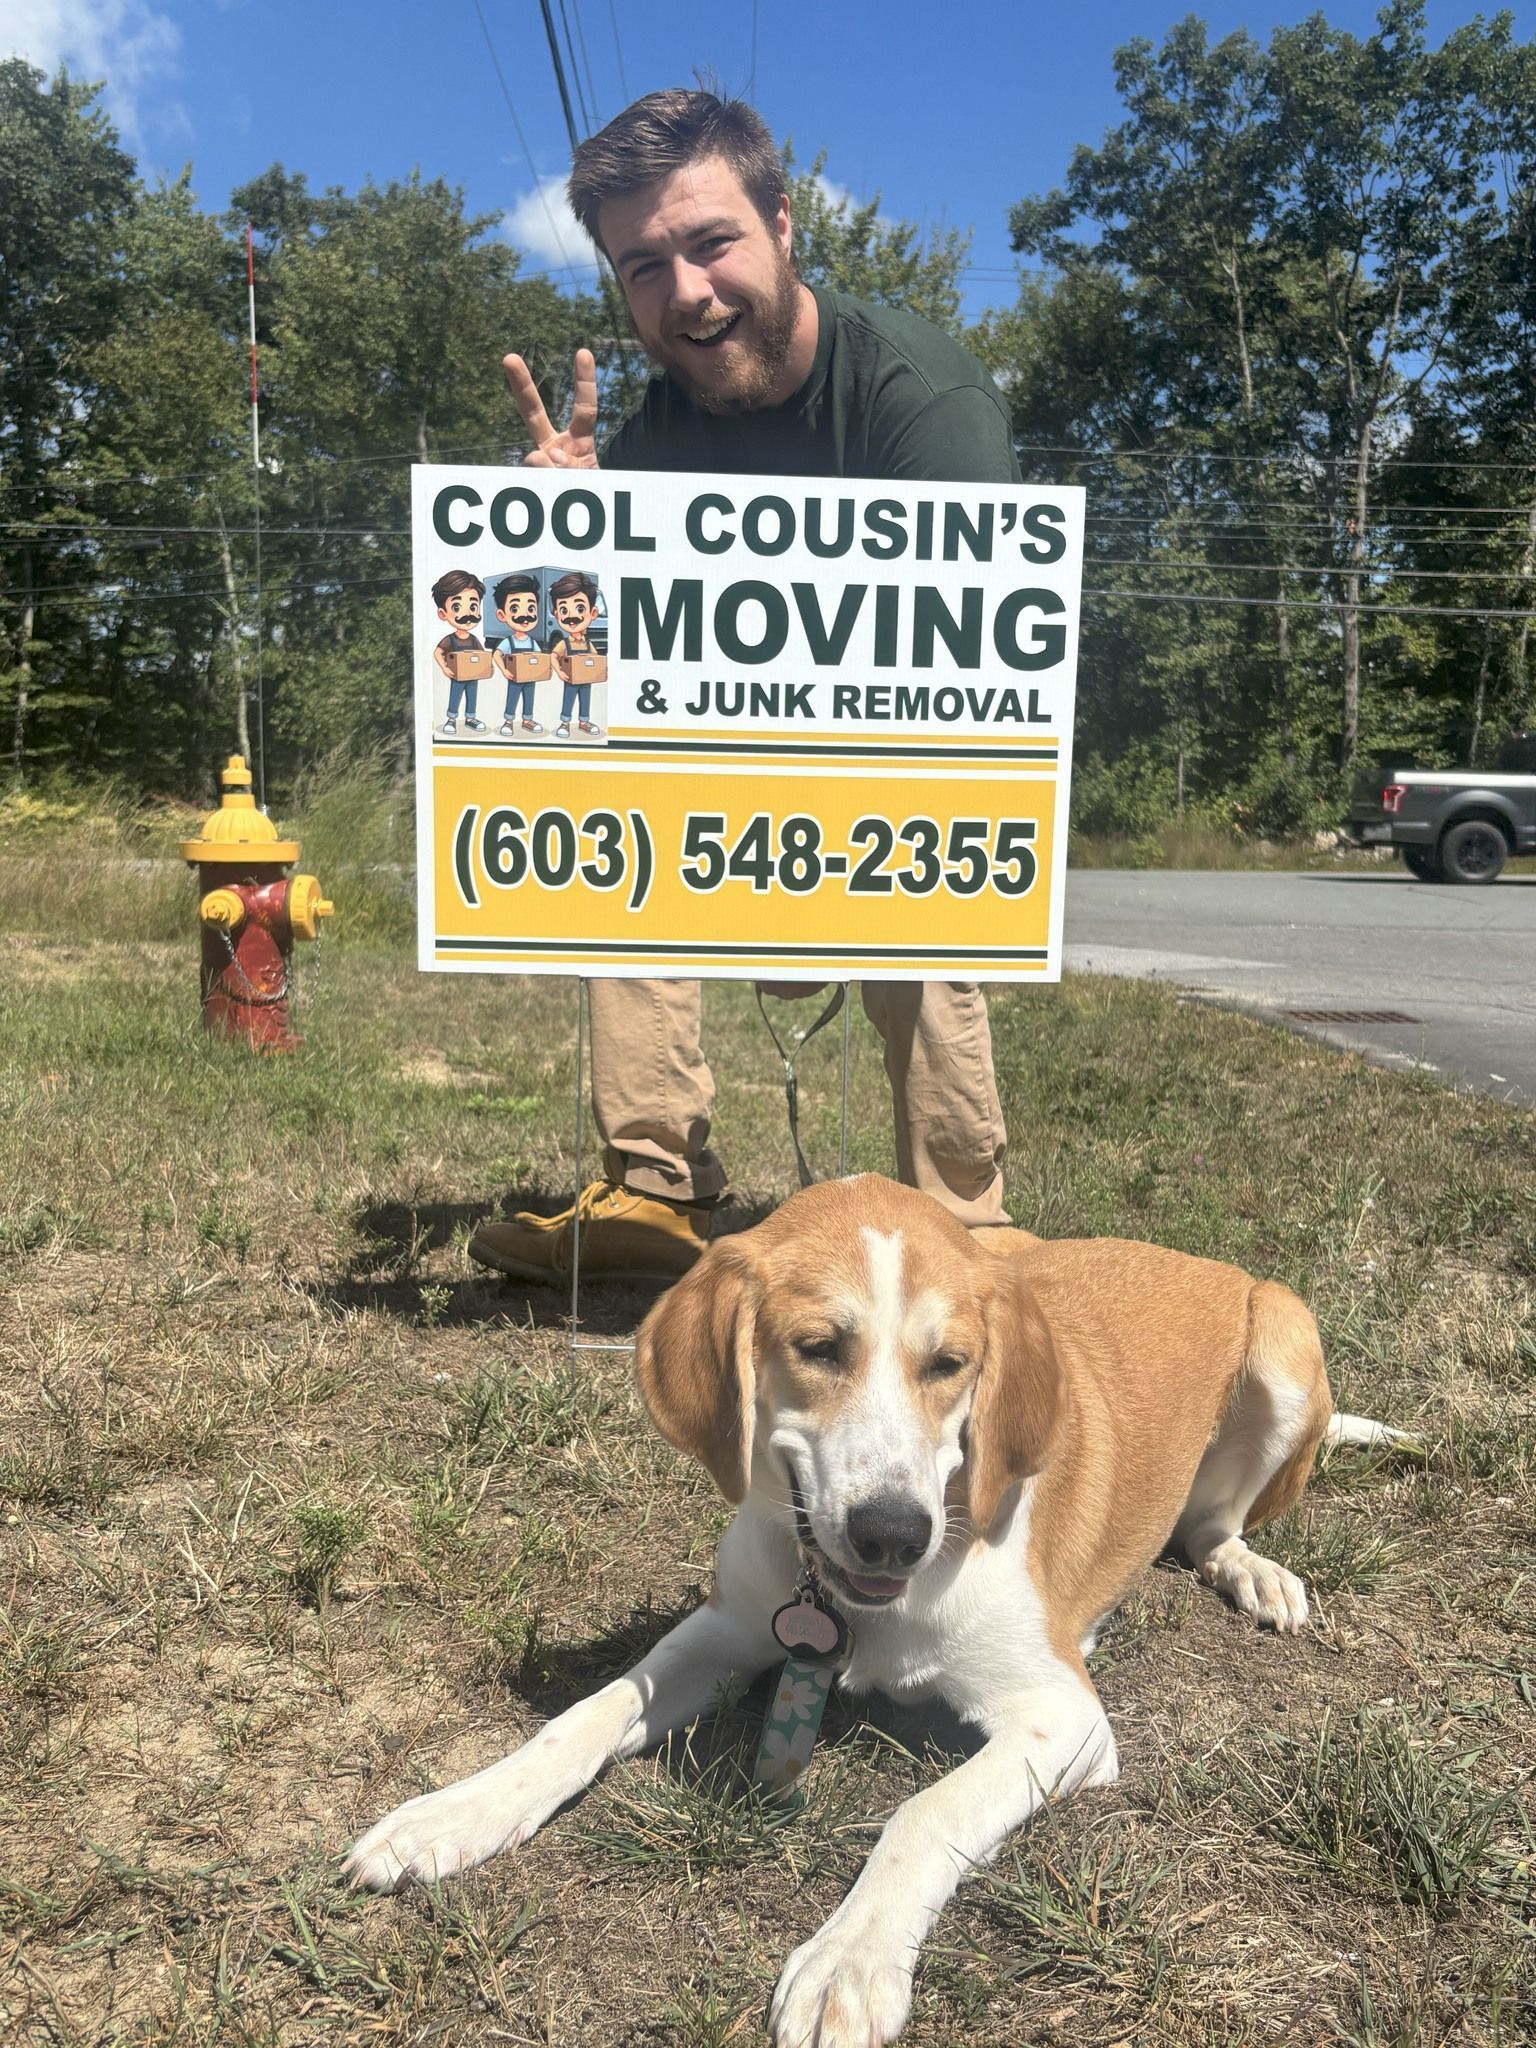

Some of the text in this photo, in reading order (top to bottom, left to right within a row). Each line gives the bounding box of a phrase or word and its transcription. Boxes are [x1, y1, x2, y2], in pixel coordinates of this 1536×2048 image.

[432, 484, 656, 552] COOL
[620, 576, 1067, 672] MOVING
[636, 679, 1052, 723] & JUNK REMOVAL
[454, 808, 1037, 909] (603) 548-2355
